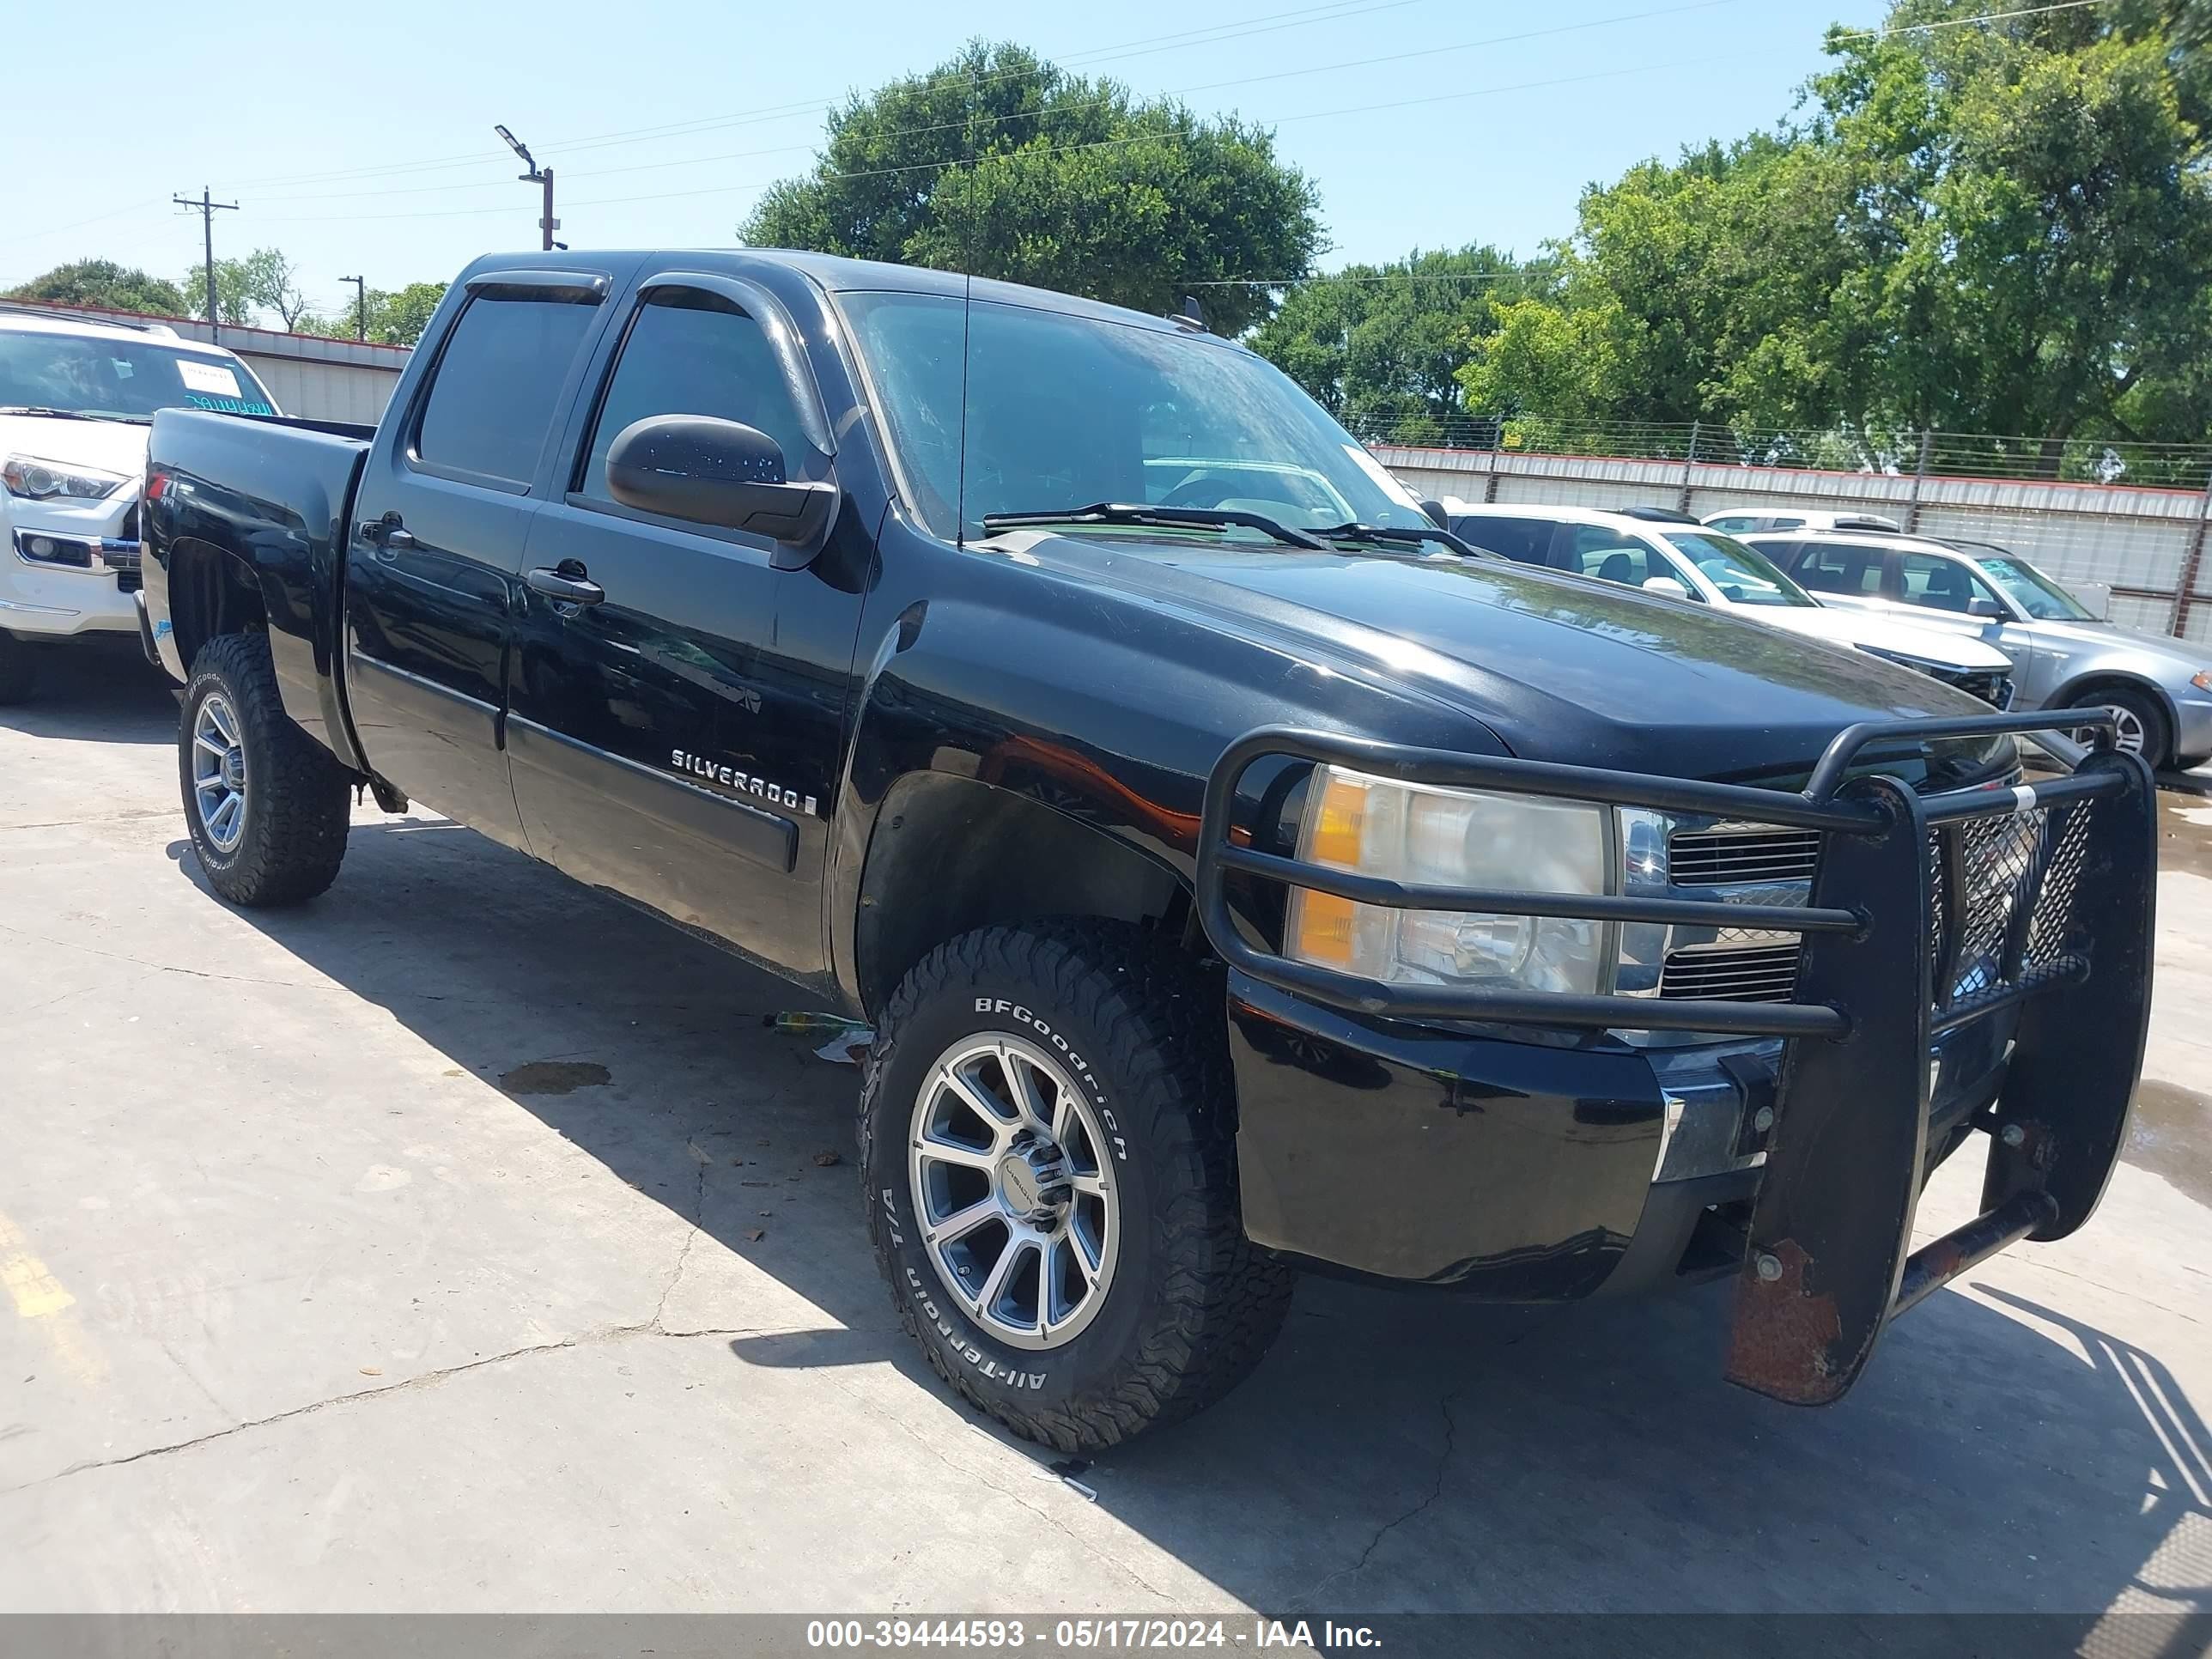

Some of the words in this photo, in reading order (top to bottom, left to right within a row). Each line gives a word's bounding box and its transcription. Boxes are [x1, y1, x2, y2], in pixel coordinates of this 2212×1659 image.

[672, 749, 798, 809] SILVERADO
[975, 997, 1127, 1161] BFGoodrich
[905, 1267, 1048, 1390] All-Terrain
